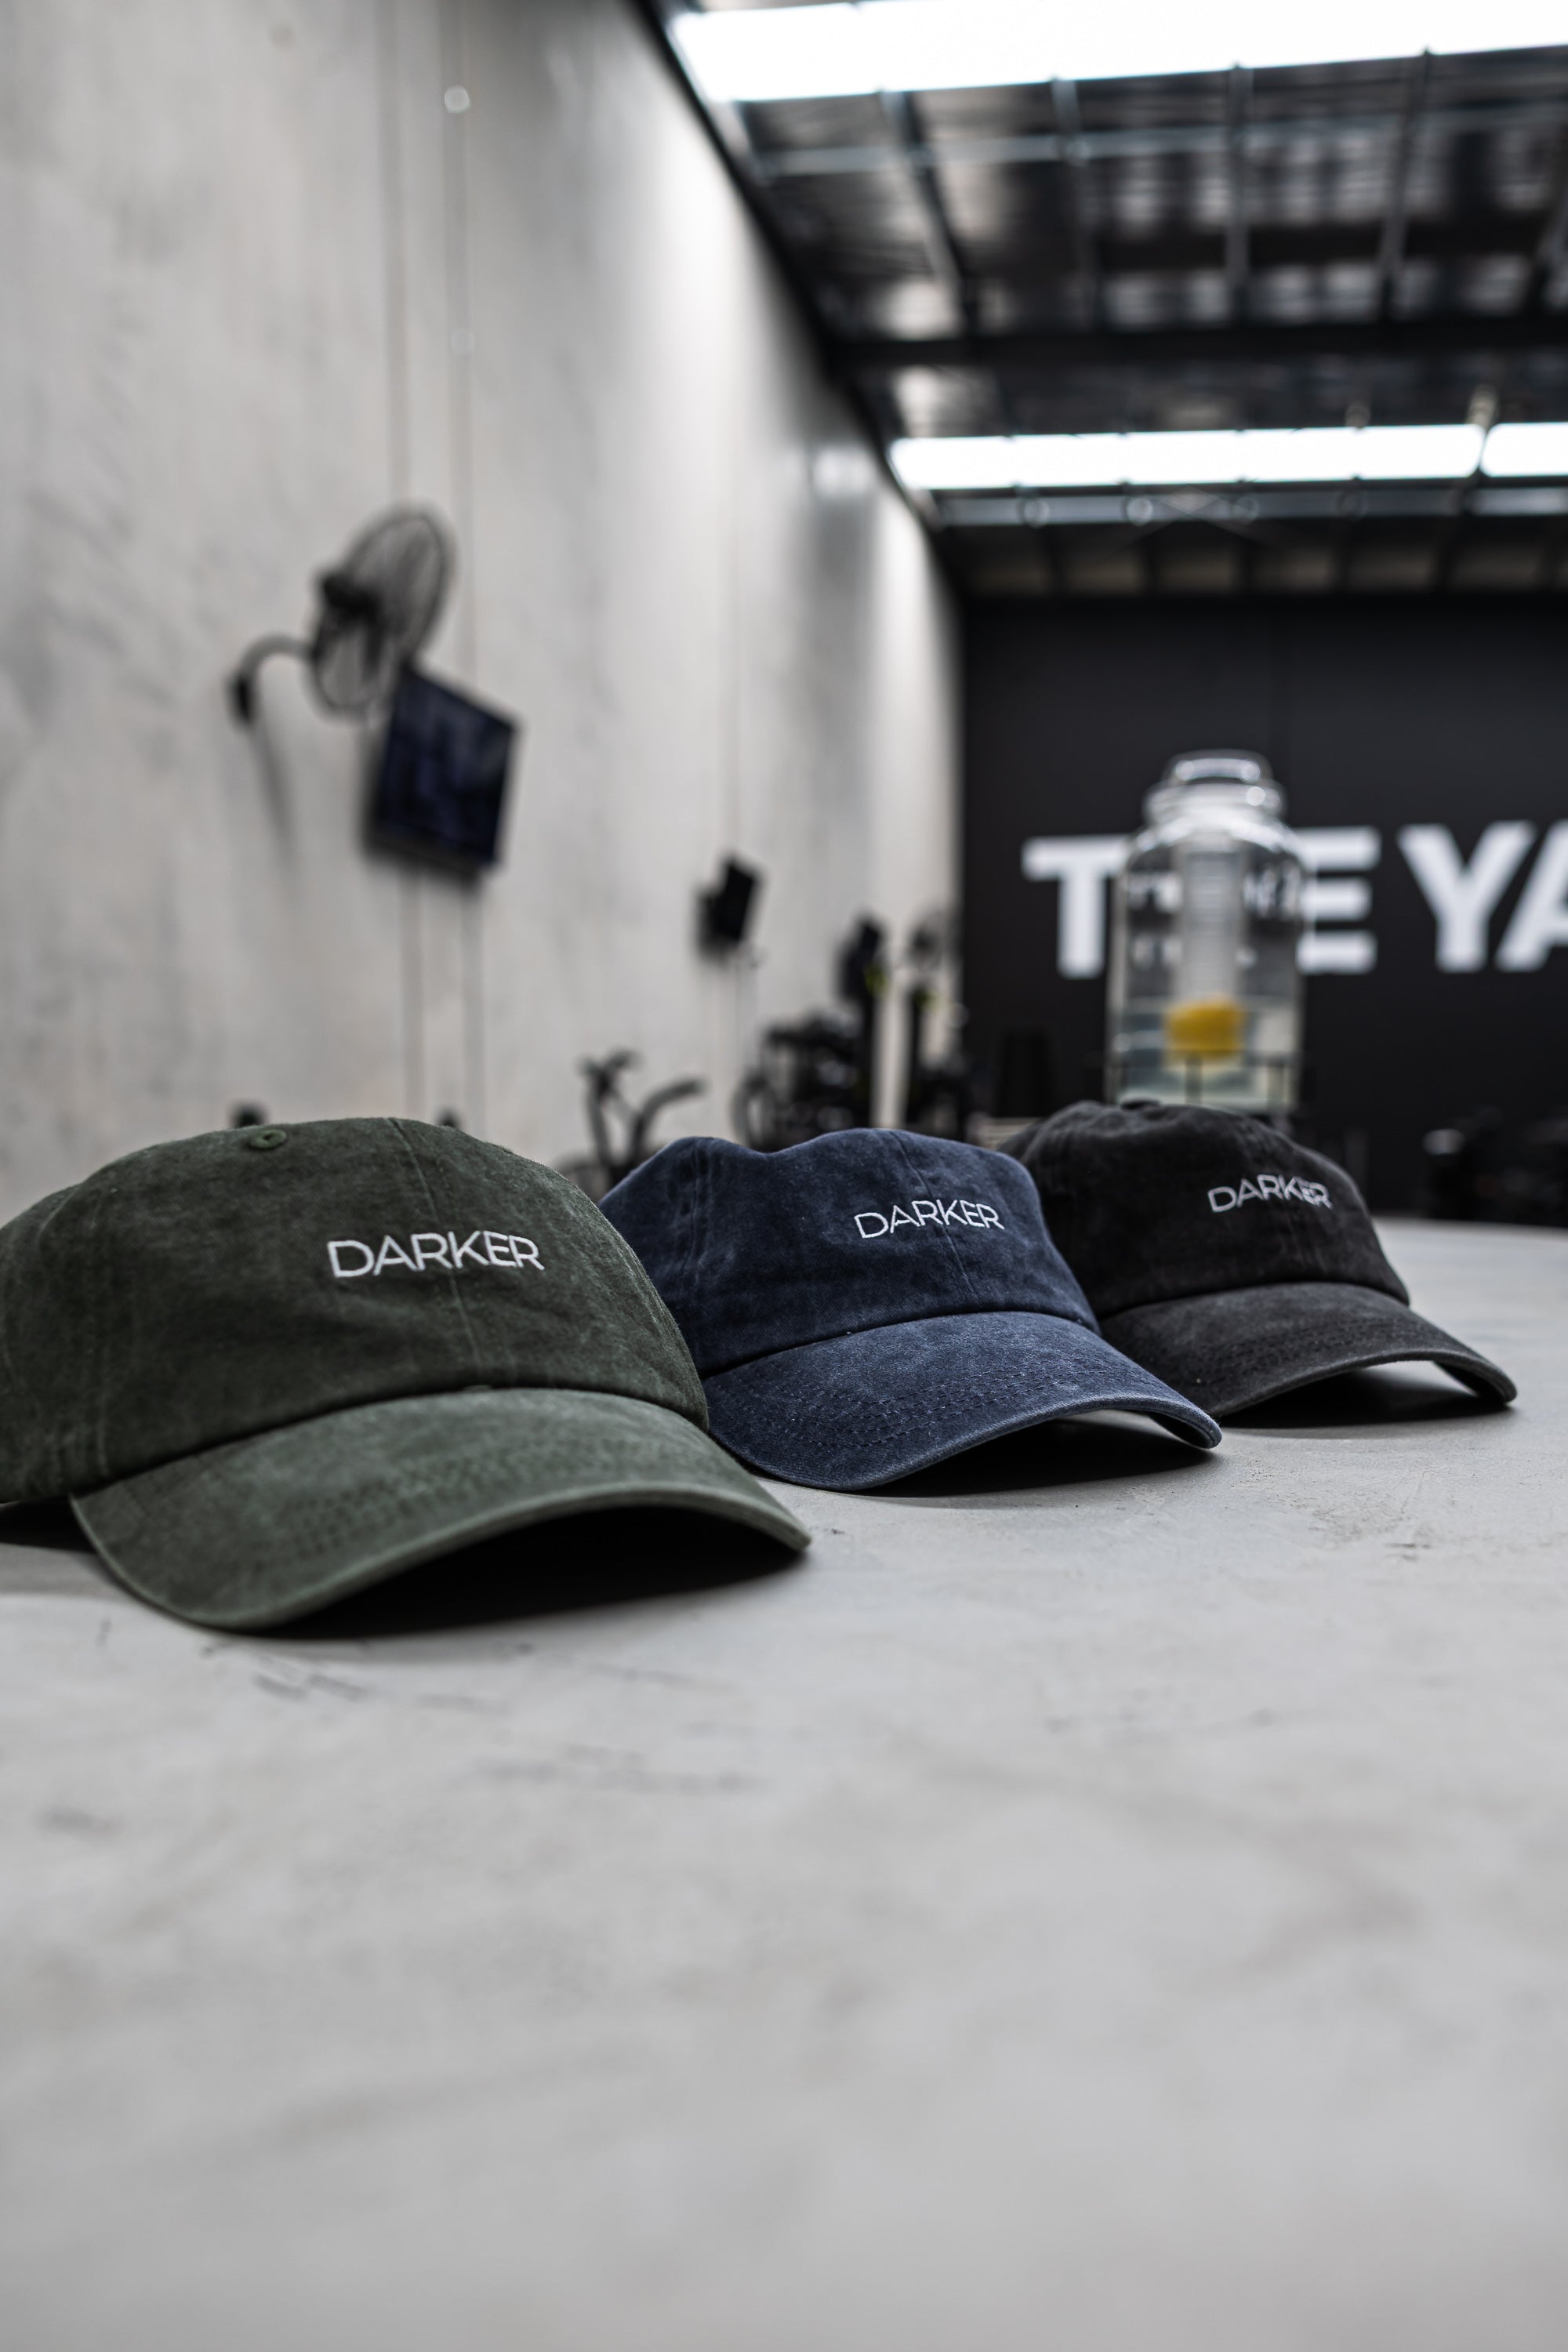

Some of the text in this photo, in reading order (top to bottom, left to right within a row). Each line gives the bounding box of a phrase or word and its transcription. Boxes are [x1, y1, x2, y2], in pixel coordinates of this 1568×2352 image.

[1022, 826, 1380, 976] TE
[1207, 1174, 1333, 1212] DARKER
[854, 1199, 1005, 1239] DARKER
[326, 1229, 545, 1278] DARKER
